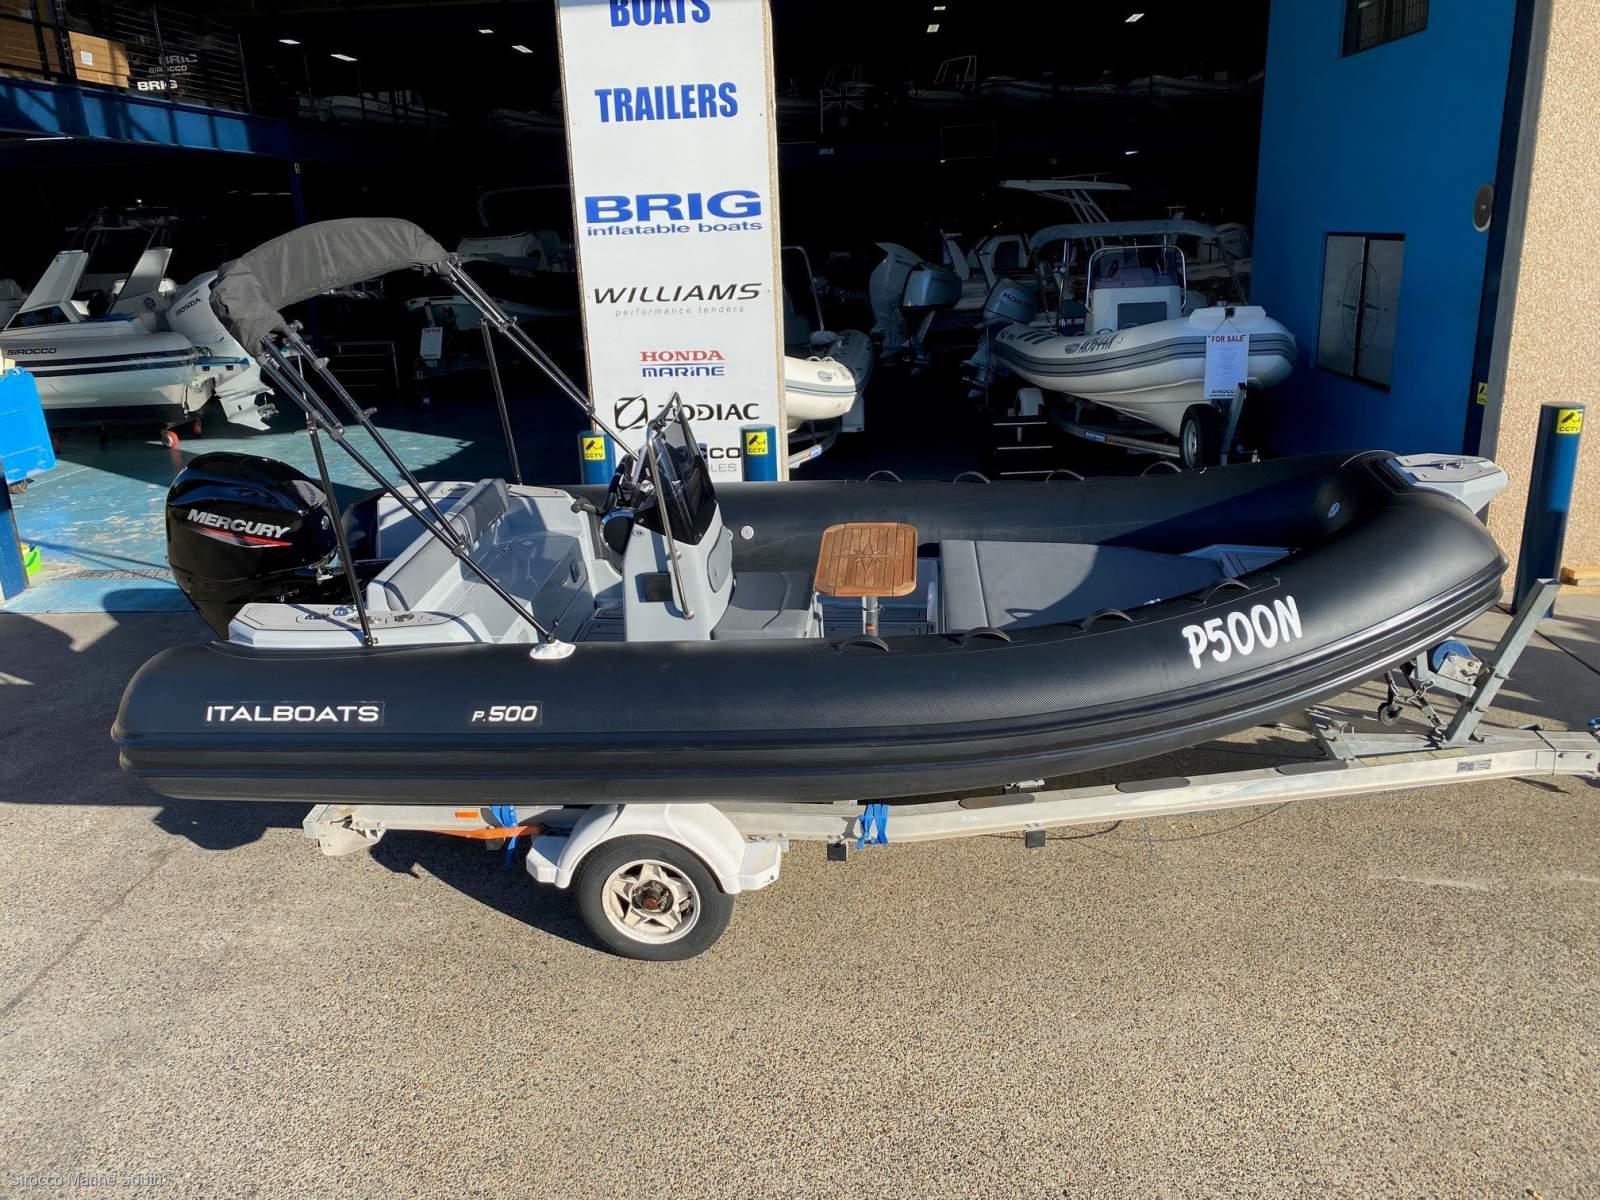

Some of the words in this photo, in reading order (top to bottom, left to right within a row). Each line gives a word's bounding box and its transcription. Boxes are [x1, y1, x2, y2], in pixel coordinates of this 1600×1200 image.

[609, 0, 711, 27] BOATS
[137, 79, 178, 91] BRIG
[594, 82, 739, 123] TRAILERS
[584, 190, 762, 223] BRIG
[587, 223, 691, 237] inflatable
[698, 221, 763, 233] boats
[593, 283, 762, 304] WILLIAMS
[615, 307, 692, 317] performance
[698, 305, 745, 315] tenders
[1211, 335, 1225, 343] FOR
[1227, 335, 1244, 343] SALE
[7, 347, 57, 356] SIROCCO
[640, 350, 726, 362] HONDA
[187, 509, 291, 539] MERCURY
[1182, 595, 1303, 670] P500N
[205, 705, 380, 722] ITALBOATS
